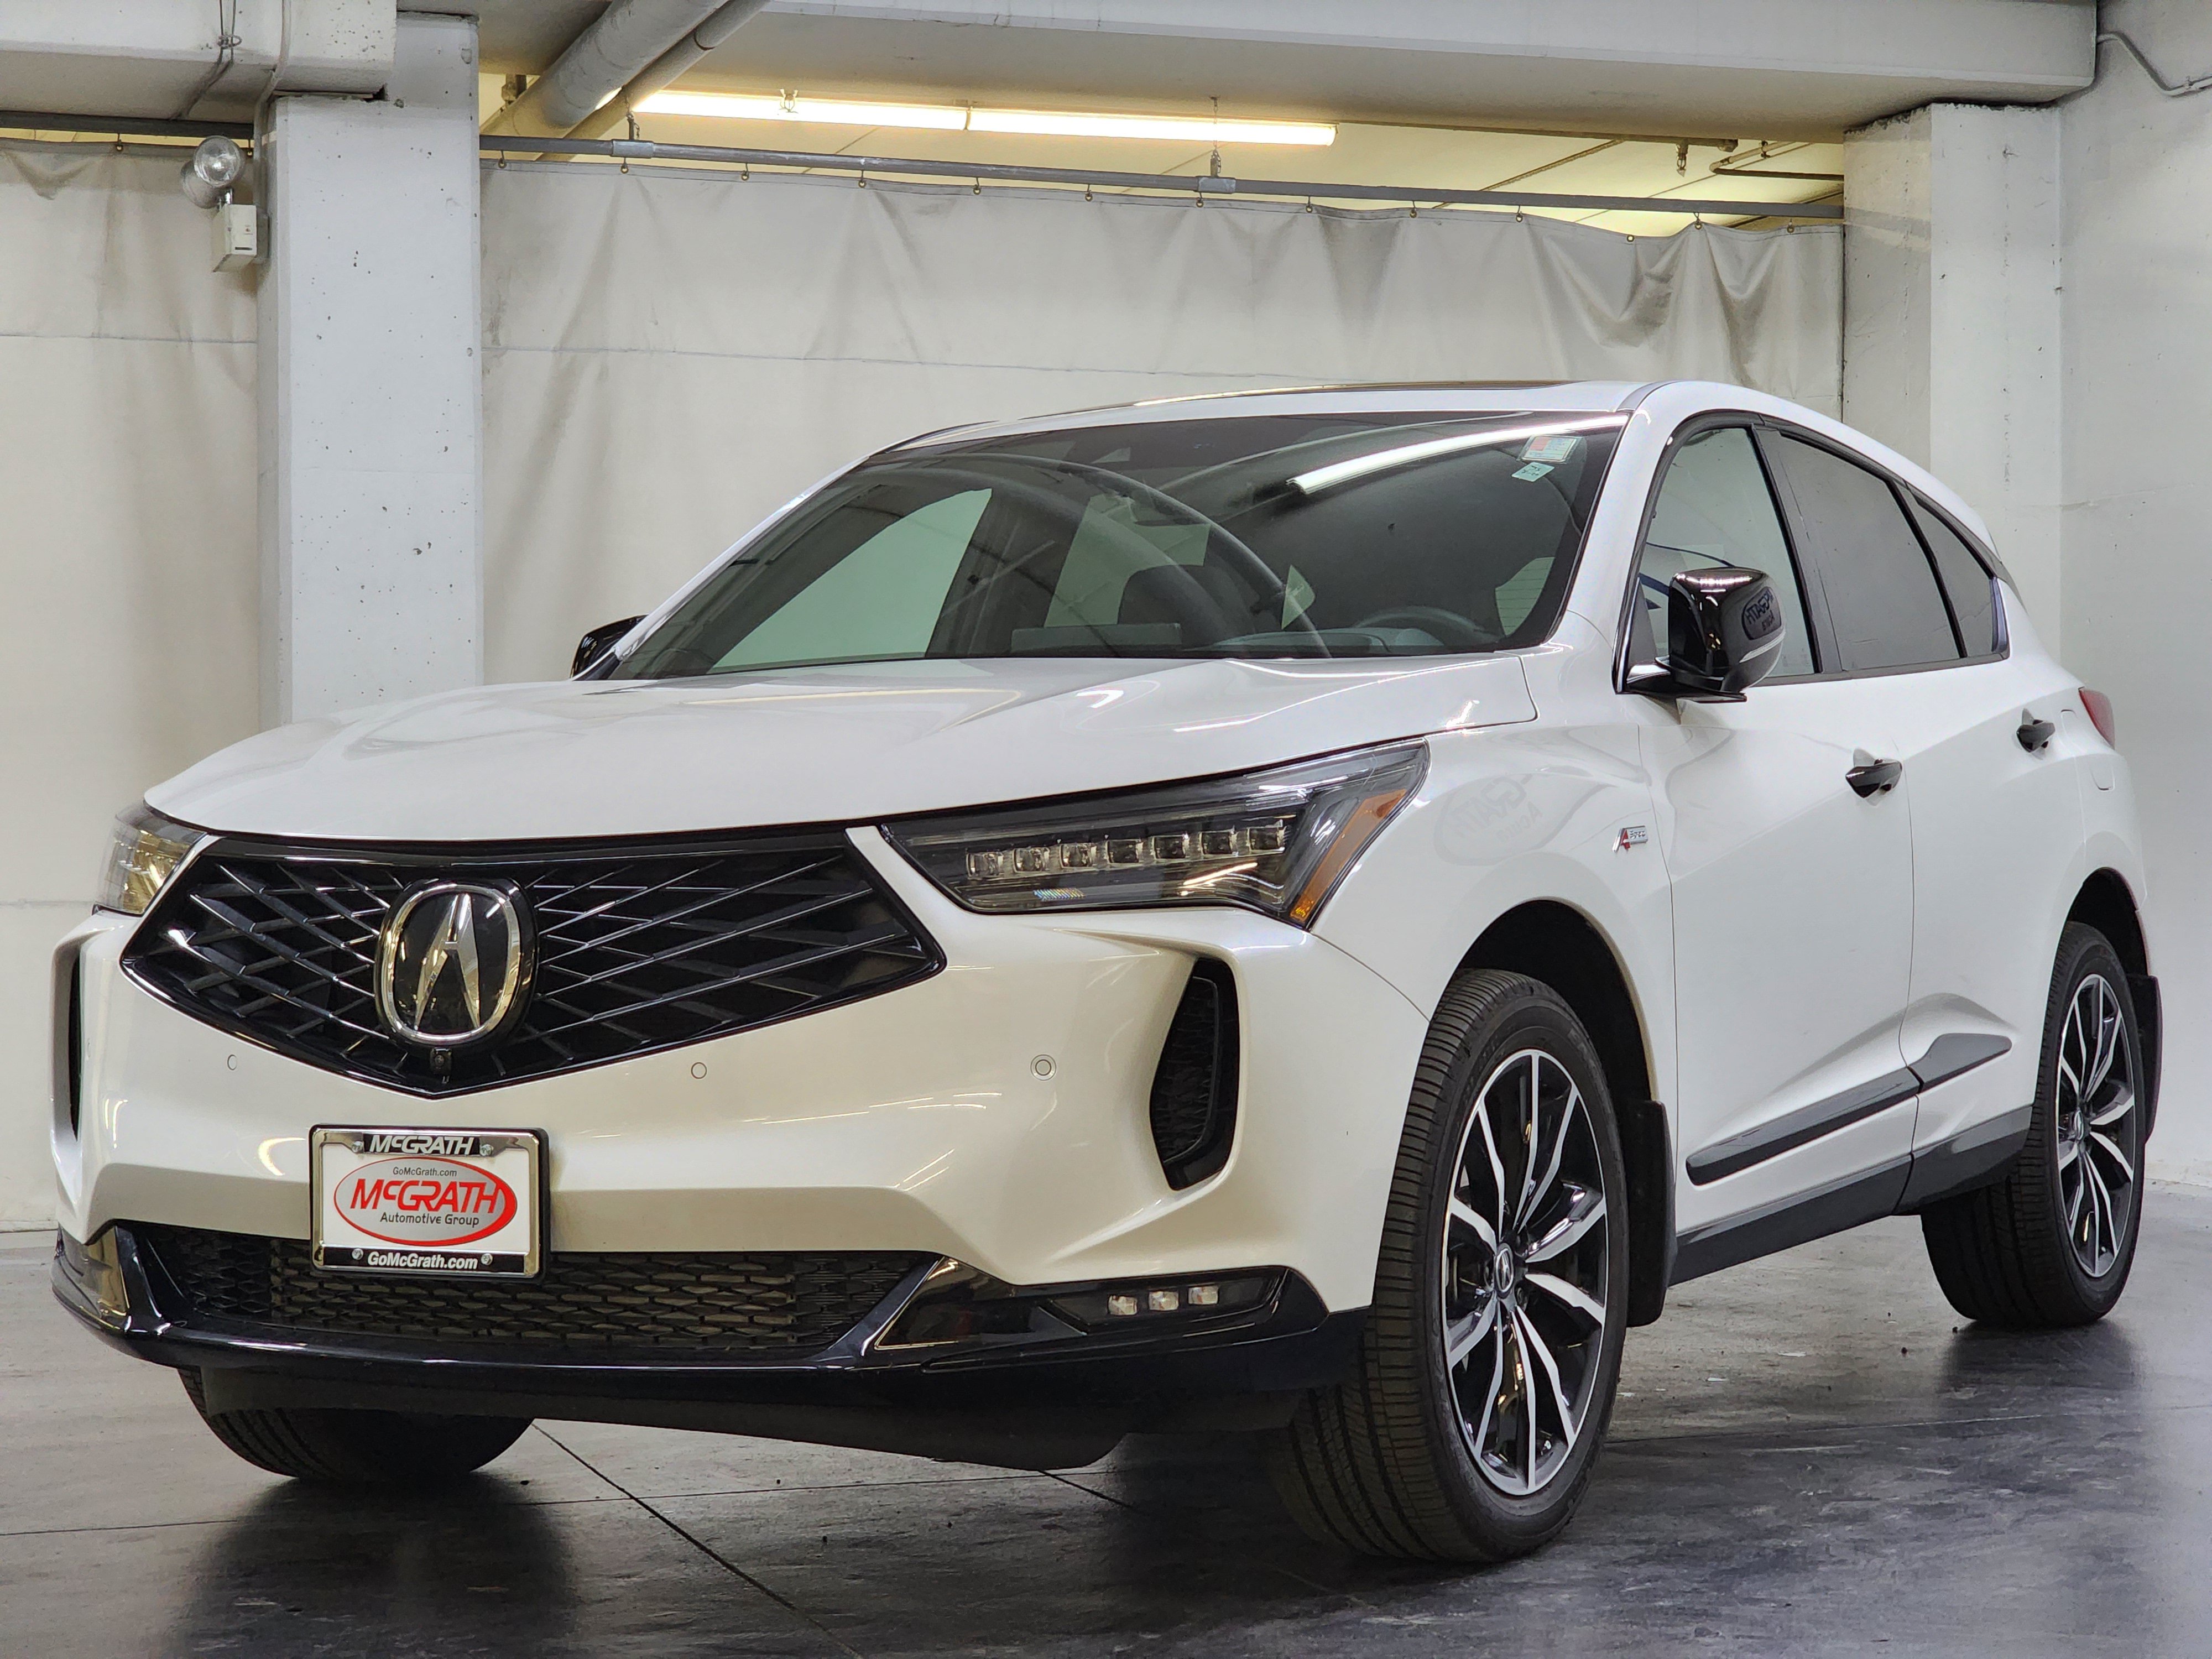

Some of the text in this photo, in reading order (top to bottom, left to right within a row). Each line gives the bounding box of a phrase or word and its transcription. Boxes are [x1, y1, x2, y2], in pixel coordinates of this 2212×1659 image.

[393, 1167, 457, 1176] GoMcGrath.com
[380, 1212, 479, 1228] Automotive Group
[368, 1251, 478, 1269] GoMcGrath.com
